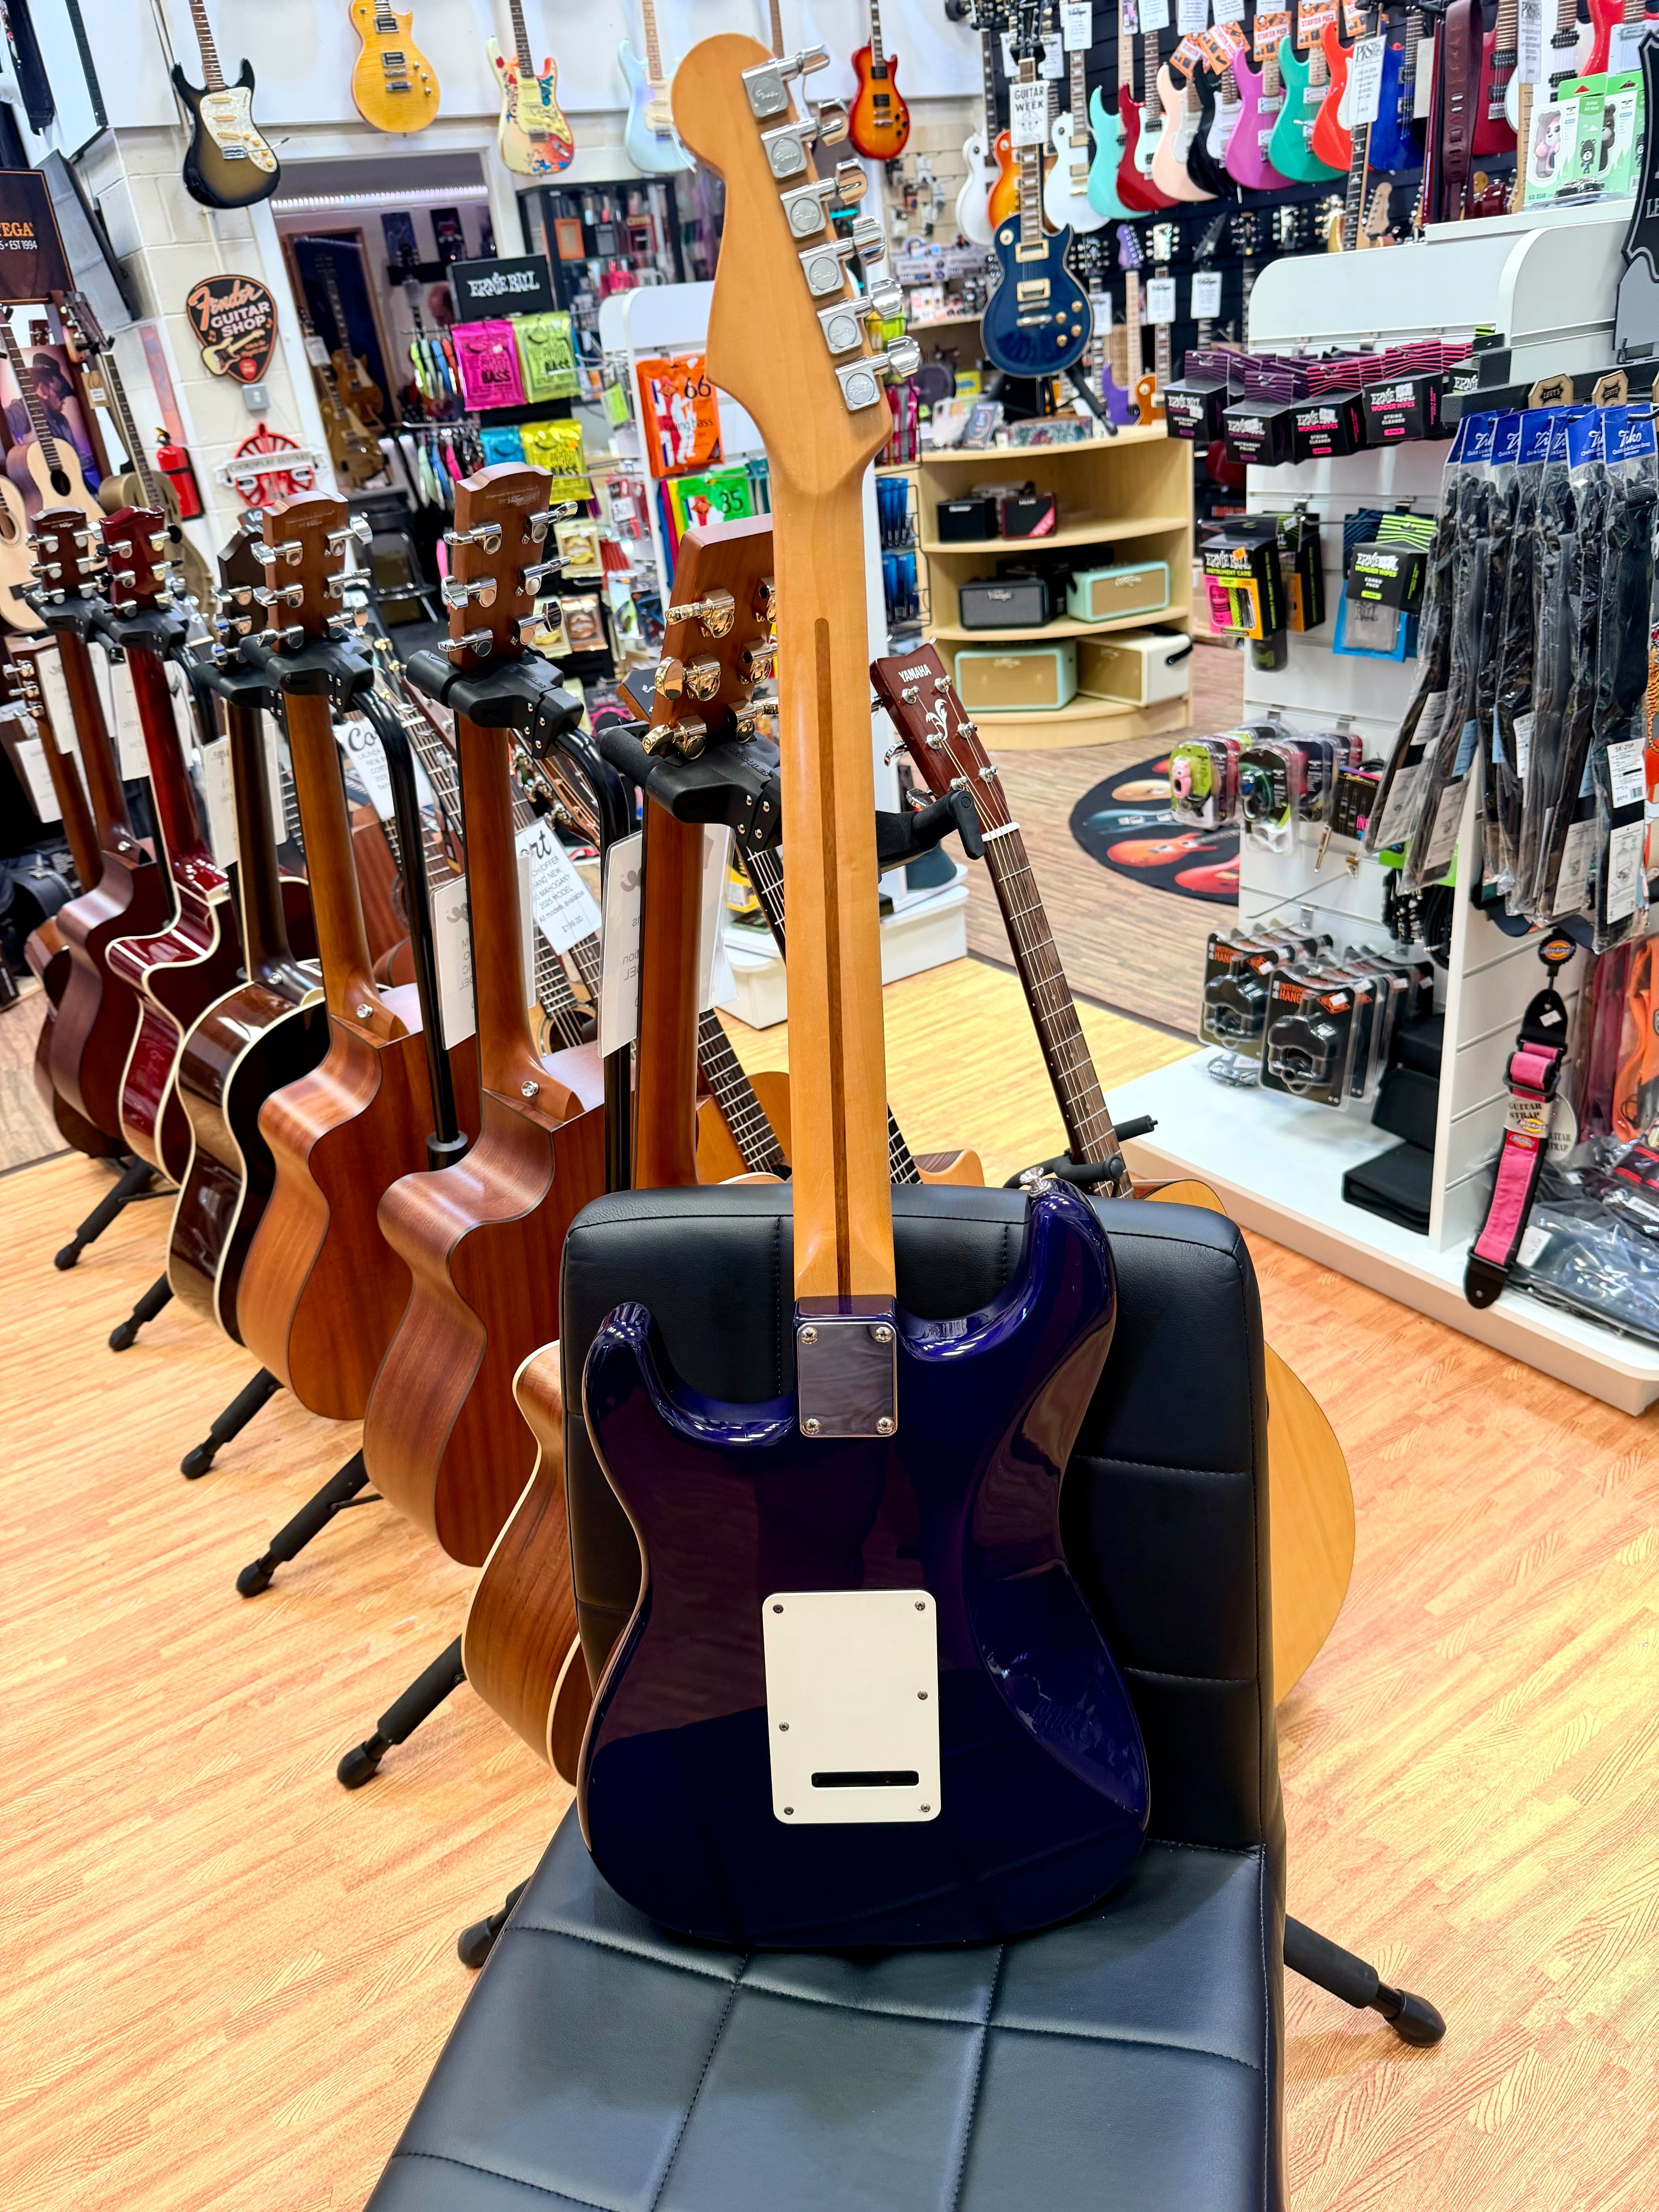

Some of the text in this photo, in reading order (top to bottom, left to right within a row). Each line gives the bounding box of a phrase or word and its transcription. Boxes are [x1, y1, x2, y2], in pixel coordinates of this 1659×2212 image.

[1302, 17, 1321, 27] STARTER
[1214, 28, 1228, 44] STARTER
[1257, 31, 1275, 40] STARTER
[1182, 42, 1199, 57] STARTER
[1356, 43, 1373, 62] PRS
[1015, 86, 1044, 100] GUITAR
[1015, 100, 1044, 112] WEEK
[0, 222, 34, 237] EGA
[467, 270, 540, 297] ERNIE BALL
[188, 279, 264, 331] Fender
[210, 301, 271, 328] GUITAR
[221, 315, 266, 337] SHOP
[481, 369, 511, 383] BASS
[1453, 375, 1479, 391] ERNI
[684, 375, 711, 399] 66
[1370, 388, 1395, 405] ERNIE
[1371, 401, 1415, 412] WONDER WIPES
[696, 416, 713, 428] bass
[1618, 424, 1642, 448] Tiko
[719, 489, 744, 514] 35
[1204, 550, 1230, 568] ERNIE
[1206, 567, 1236, 576] INSTRUMENT
[1355, 564, 1398, 578] WONDER WIPES
[1364, 576, 1383, 584] COMBO
[898, 664, 932, 683] YAMAHA
[349, 728, 376, 751] Co
[541, 855, 560, 871] OFFER
[547, 869, 562, 880] NEW
[539, 873, 571, 898] MAHOGANY
[539, 898, 554, 910] 2025
[553, 885, 574, 900] MODEL
[546, 905, 564, 919] models
[1279, 990, 1302, 1004] HANG
[1509, 1102, 1542, 1111] GUITAR
[1549, 1142, 1569, 1151] TRAP
